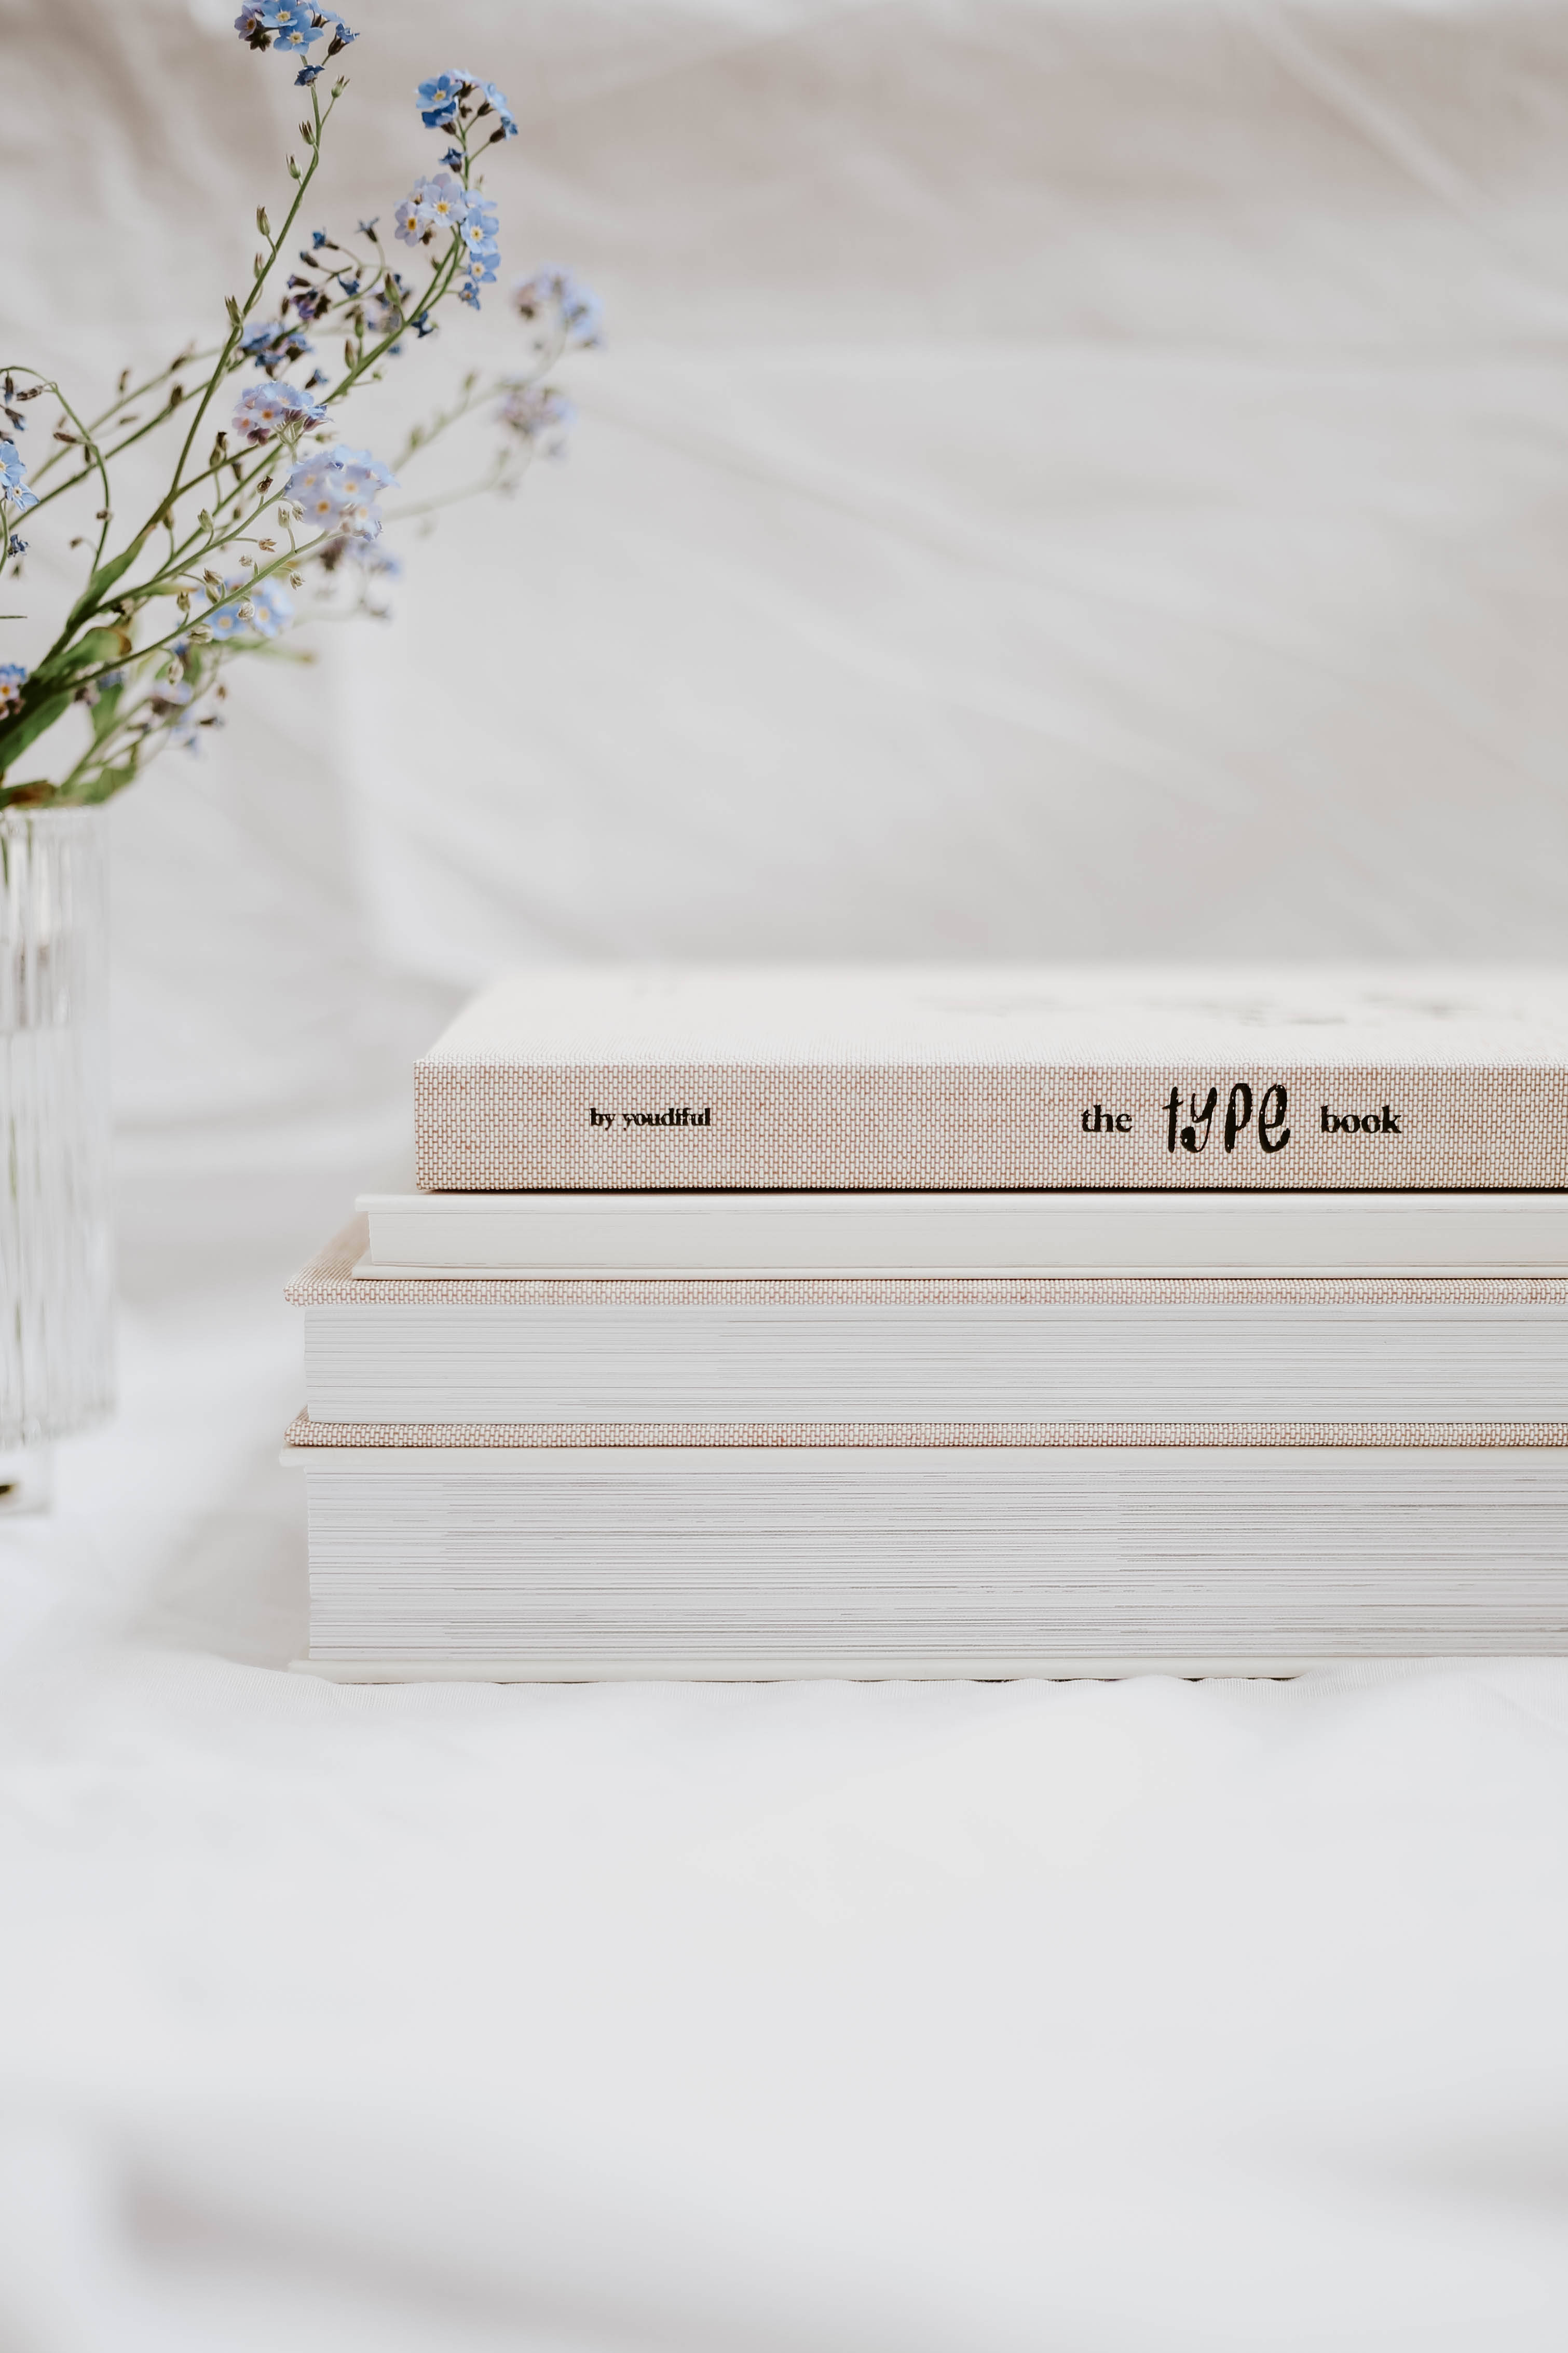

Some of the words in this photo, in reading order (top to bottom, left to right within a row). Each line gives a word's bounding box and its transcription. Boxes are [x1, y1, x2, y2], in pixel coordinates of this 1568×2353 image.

[590, 1107, 616, 1131] by
[1081, 1104, 1133, 1132] the
[1162, 1083, 1291, 1154] type
[1320, 1105, 1402, 1133] book
